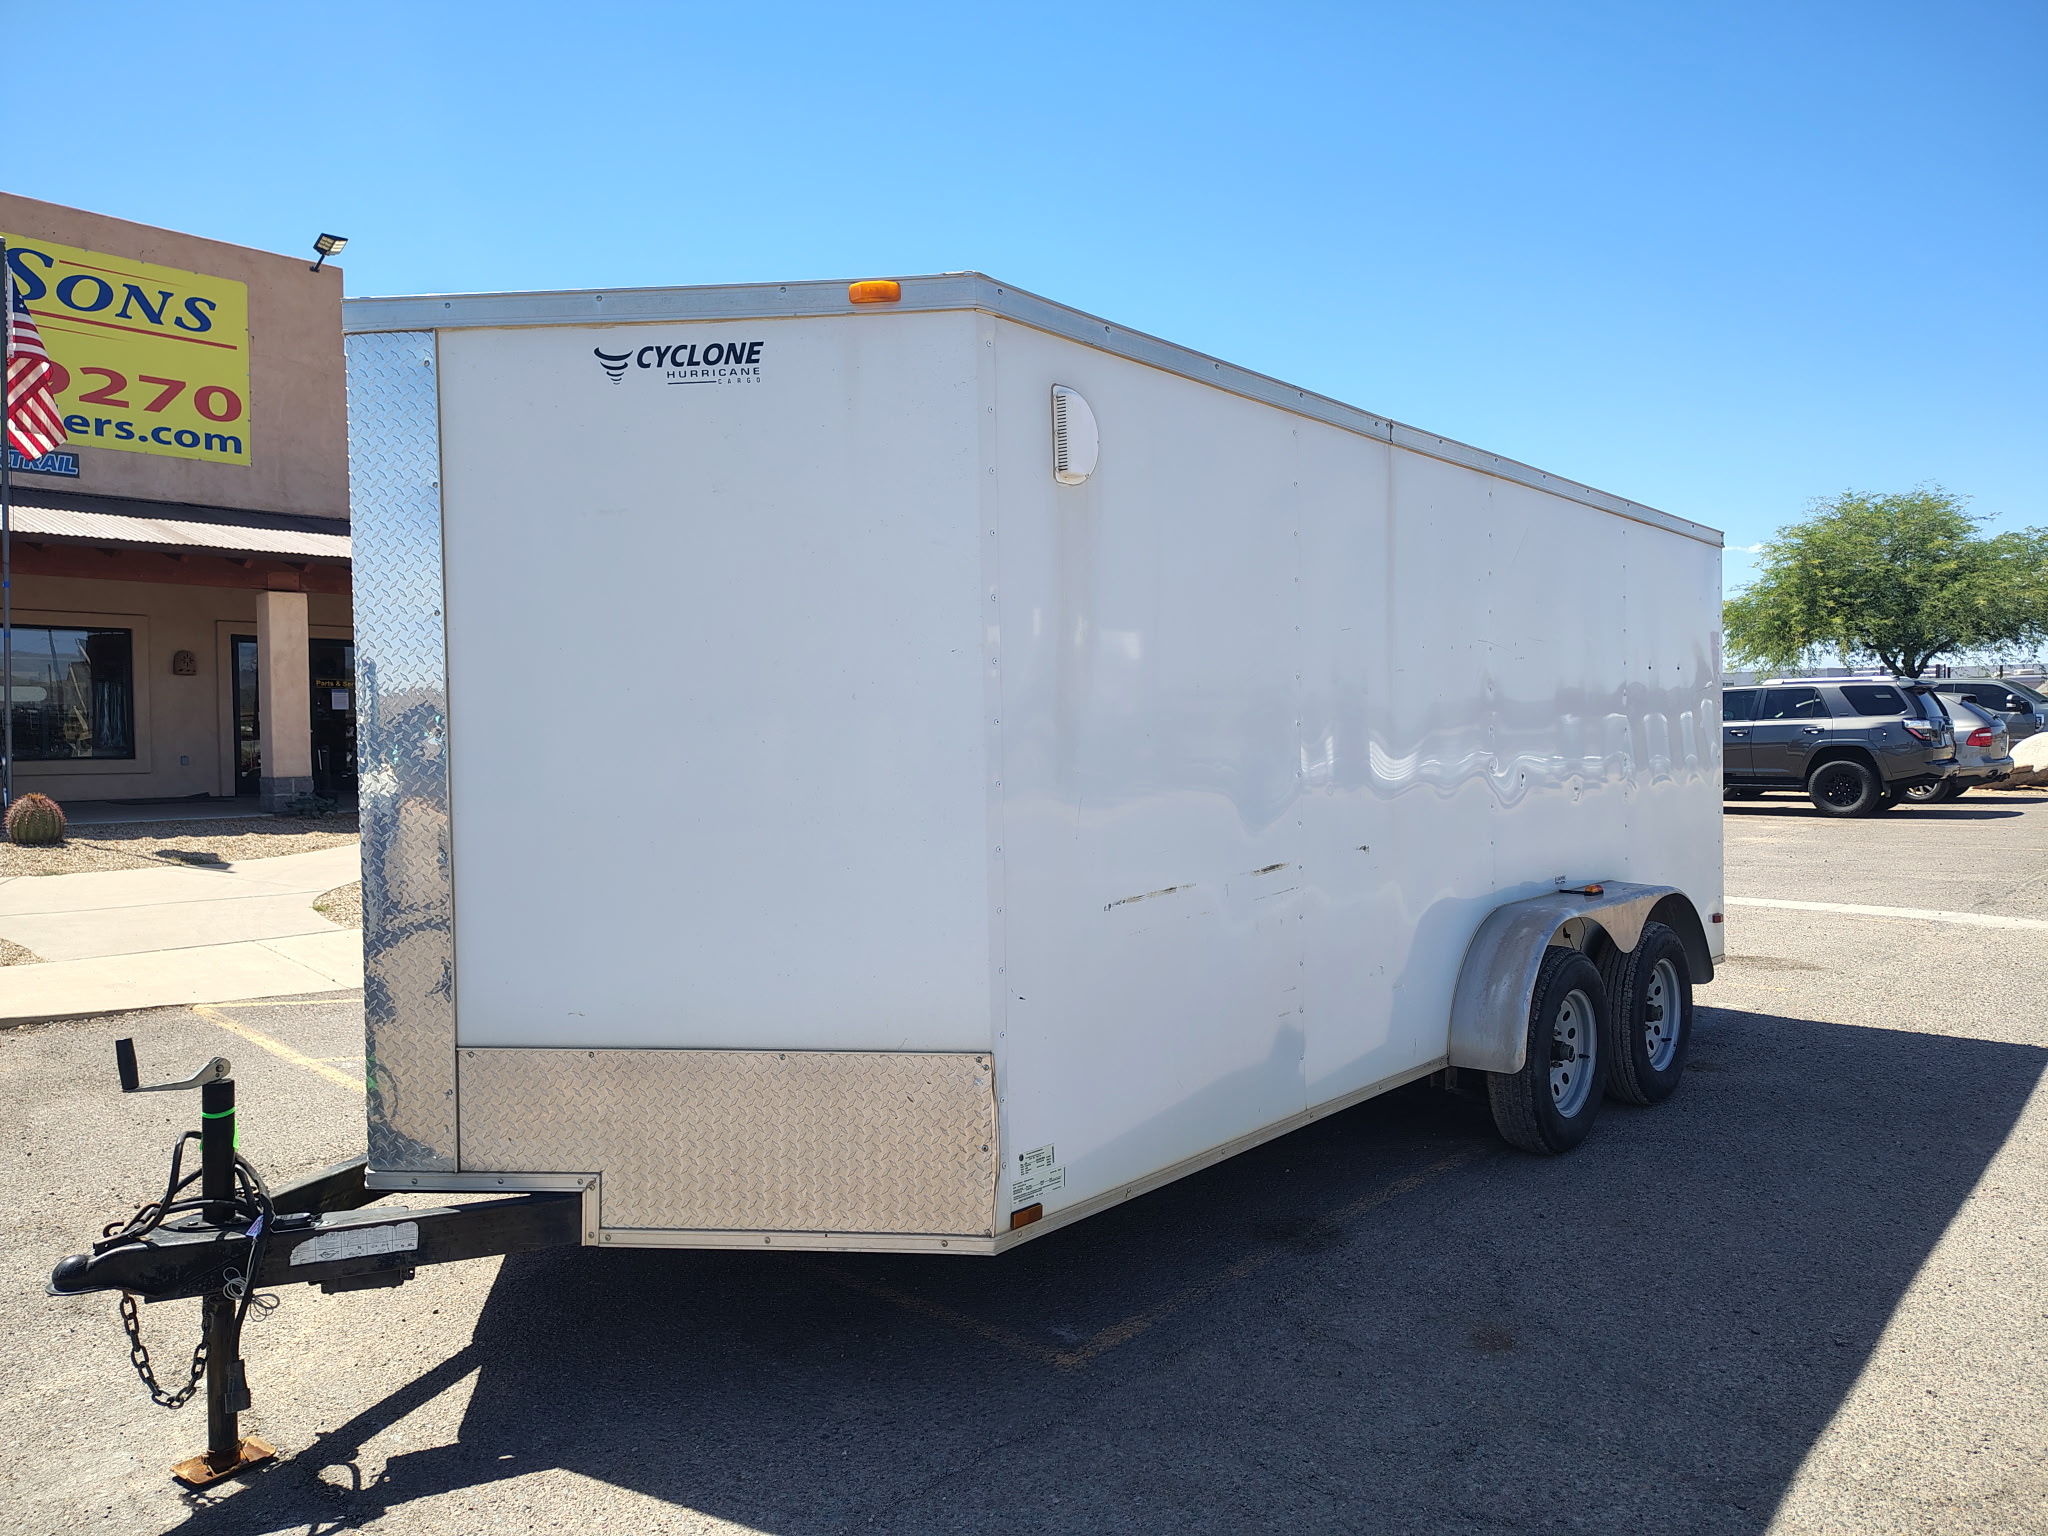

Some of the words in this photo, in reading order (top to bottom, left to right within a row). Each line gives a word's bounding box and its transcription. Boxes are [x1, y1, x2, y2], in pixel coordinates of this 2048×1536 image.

[6, 247, 217, 333] SONS
[636, 341, 764, 369] CYCLONE
[666, 367, 760, 379] HURRICANE
[58, 409, 242, 454] ers.com
[8, 449, 78, 475] TRAIL
